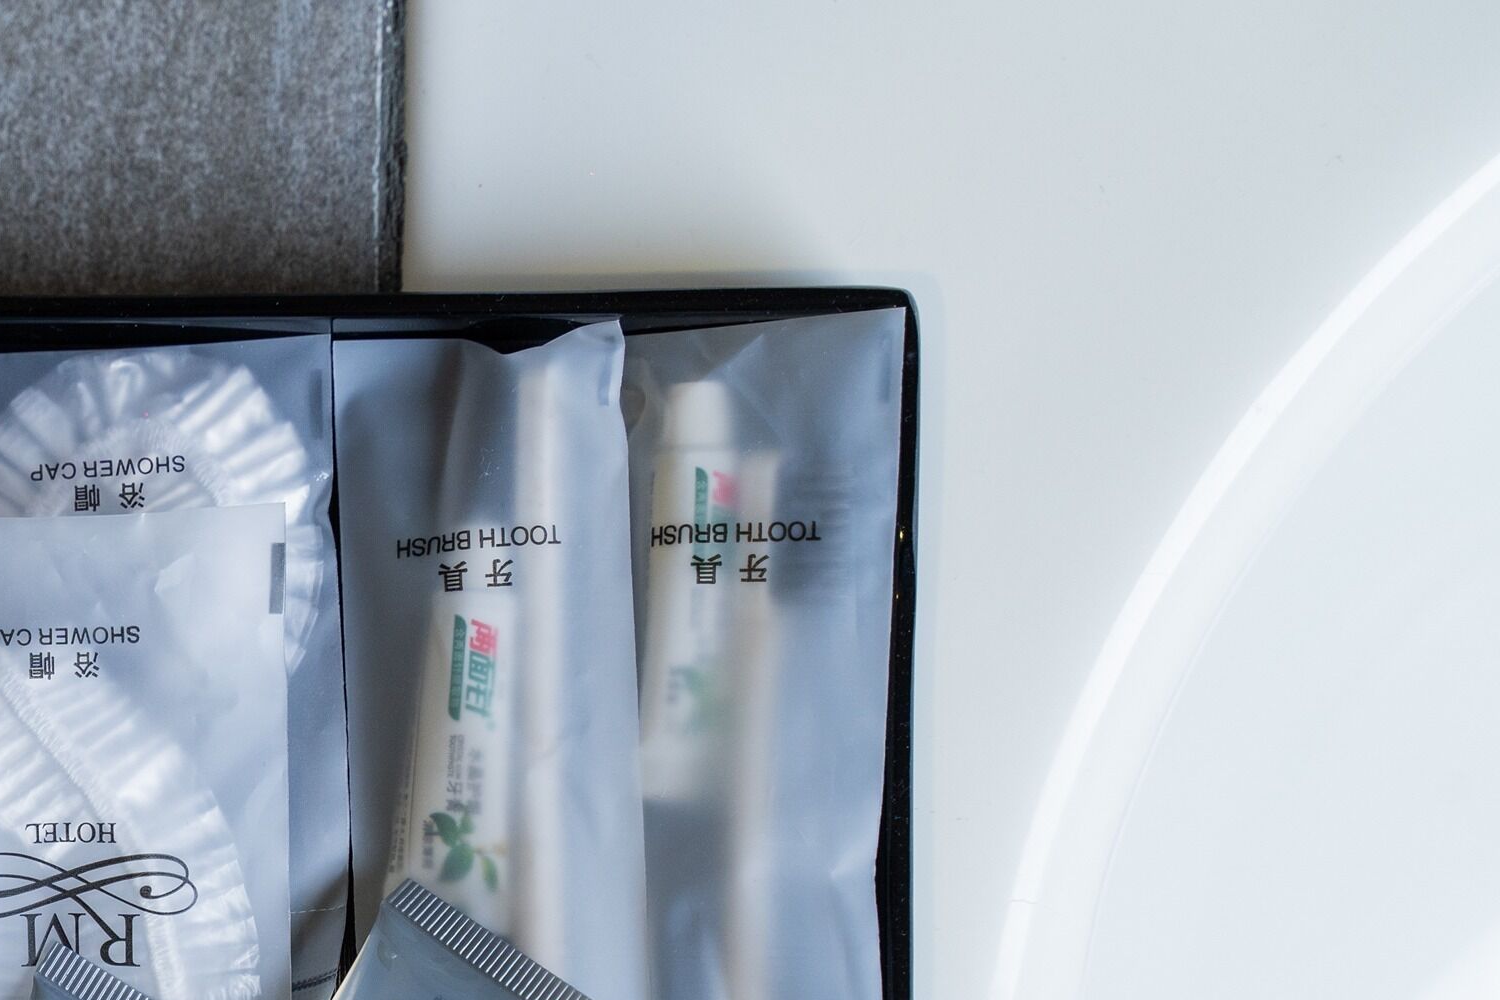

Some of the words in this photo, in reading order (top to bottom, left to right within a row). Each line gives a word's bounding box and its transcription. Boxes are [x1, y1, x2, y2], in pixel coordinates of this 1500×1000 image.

[30, 462, 76, 481] CAP
[83, 455, 185, 478] SHOWER
[74, 482, 145, 512] 浴帽
[396, 530, 471, 559] BRUSH
[479, 525, 561, 548] TOOTH
[651, 522, 728, 547] BRUSH
[736, 521, 821, 543] TOOTH
[438, 559, 513, 592] 牙具
[690, 553, 770, 584] 牙具
[39, 626, 140, 645] SHOWER
[29, 652, 100, 680] 浴帽
[25, 822, 116, 844] HOTEL
[20, 913, 140, 967] RM
